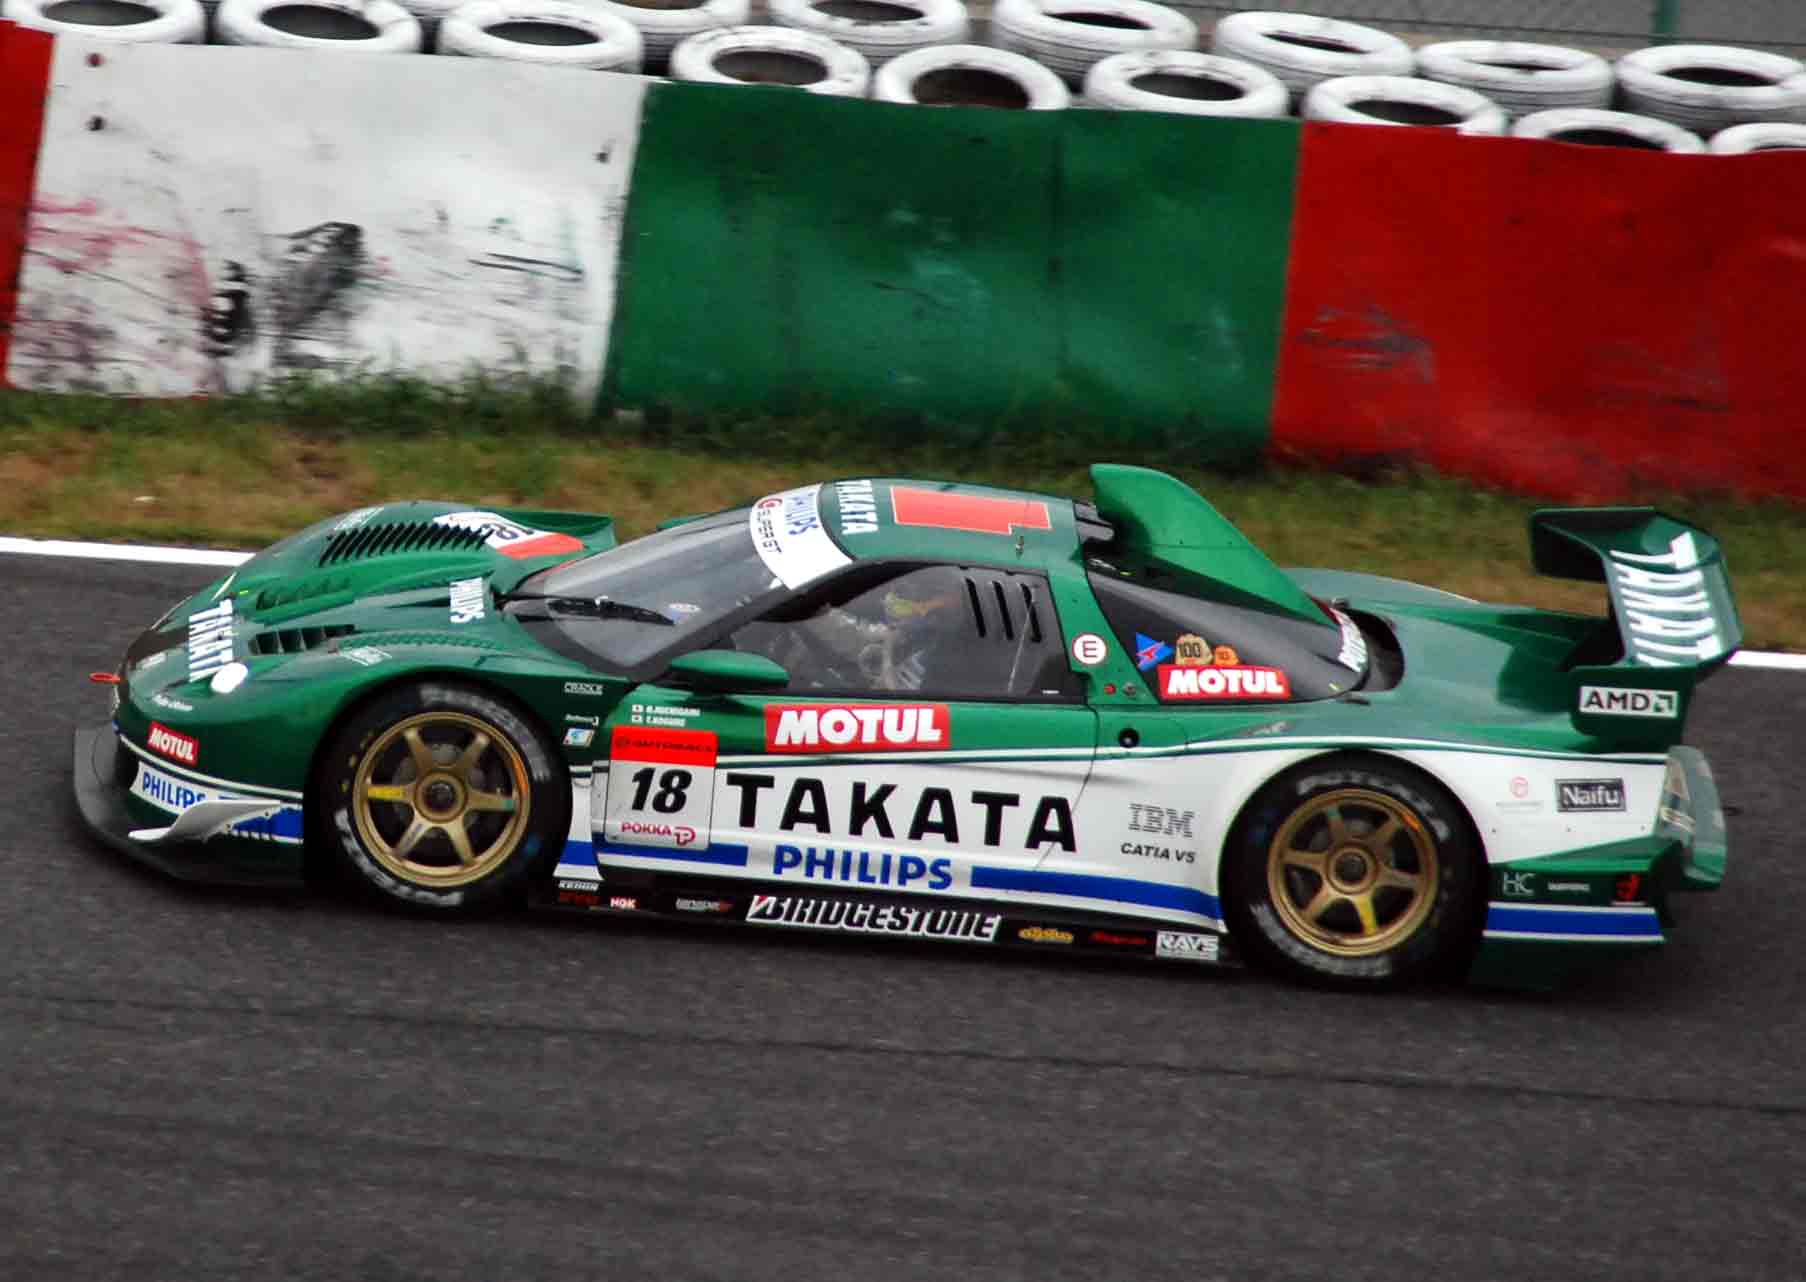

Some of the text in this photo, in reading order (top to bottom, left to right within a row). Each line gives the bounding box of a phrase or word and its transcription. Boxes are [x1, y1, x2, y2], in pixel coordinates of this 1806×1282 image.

[1082, 640, 1098, 658] E
[1167, 669, 1284, 694] MOTUL
[1584, 690, 1650, 711] AMD
[774, 708, 942, 745] MOTUL
[149, 728, 193, 761] MOTUL
[631, 767, 693, 814] 18
[1562, 785, 1620, 806] Naifu
[621, 822, 672, 836] POKKA
[726, 772, 1078, 853] TAKATA
[1128, 803, 1194, 838] IBM
[772, 844, 954, 890] PHILIPS
[1121, 843, 1170, 860] CATIA
[746, 895, 1002, 943] BRIDGESTONE
